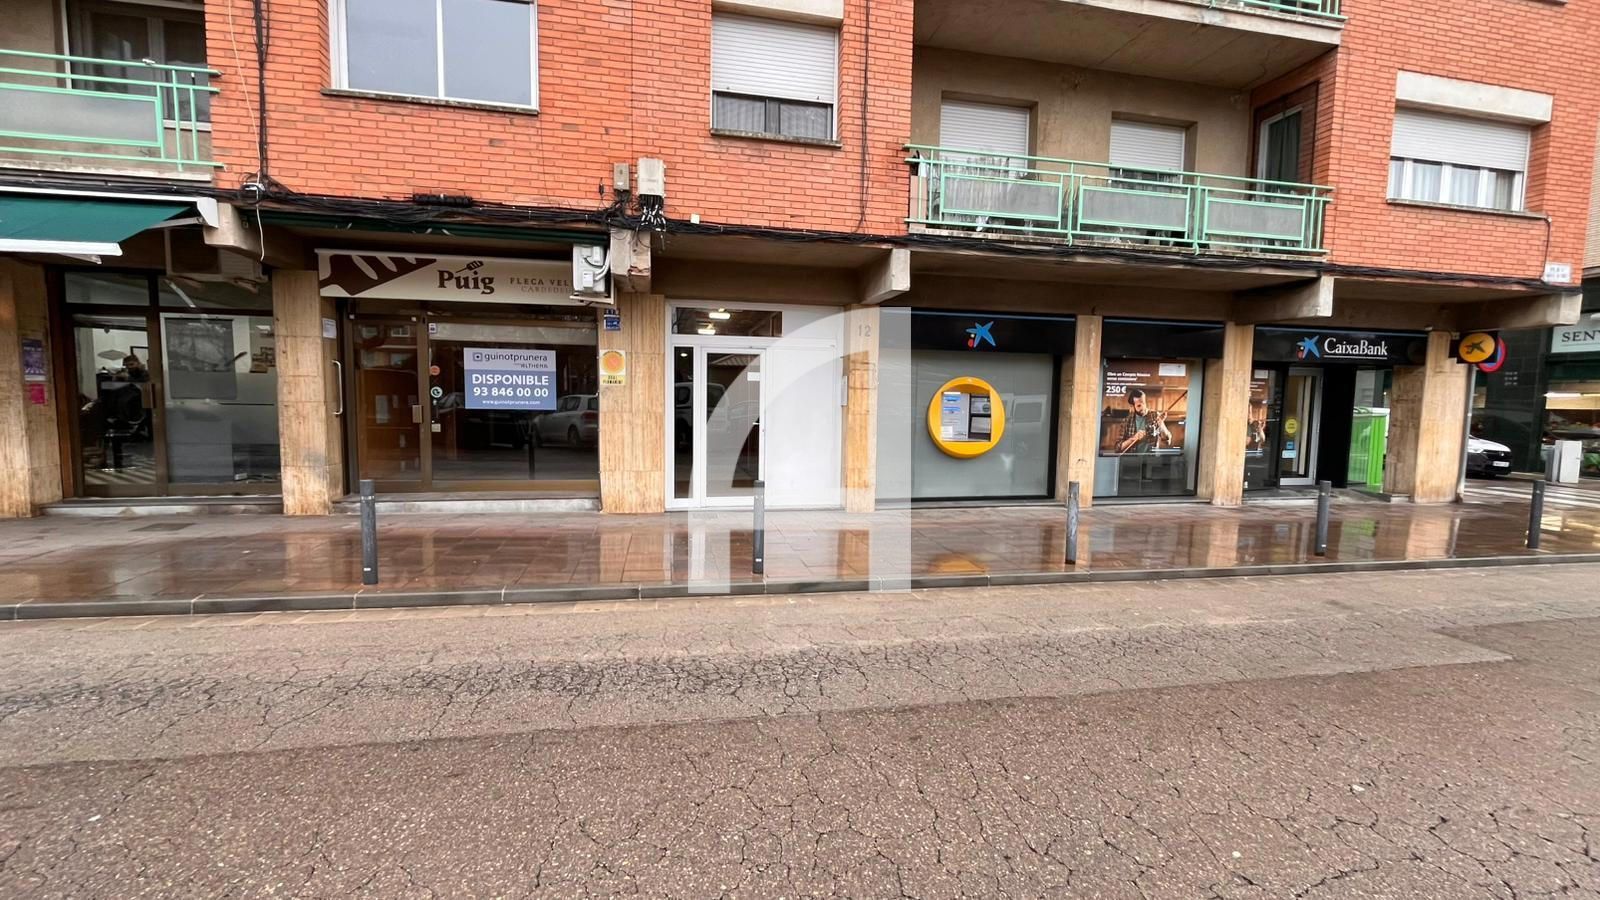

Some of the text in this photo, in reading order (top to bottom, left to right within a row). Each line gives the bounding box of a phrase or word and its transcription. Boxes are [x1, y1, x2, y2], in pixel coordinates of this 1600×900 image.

[437, 270, 495, 295] Puig
[510, 277, 573, 287] FLECA VEL
[858, 324, 871, 337] 12
[1561, 330, 1600, 343] SEN
[1323, 337, 1388, 356] CaixaBank
[484, 352, 548, 362] guinotprunera
[472, 374, 549, 386] DISPONIBLE
[473, 387, 549, 397] 93 846 00 00
